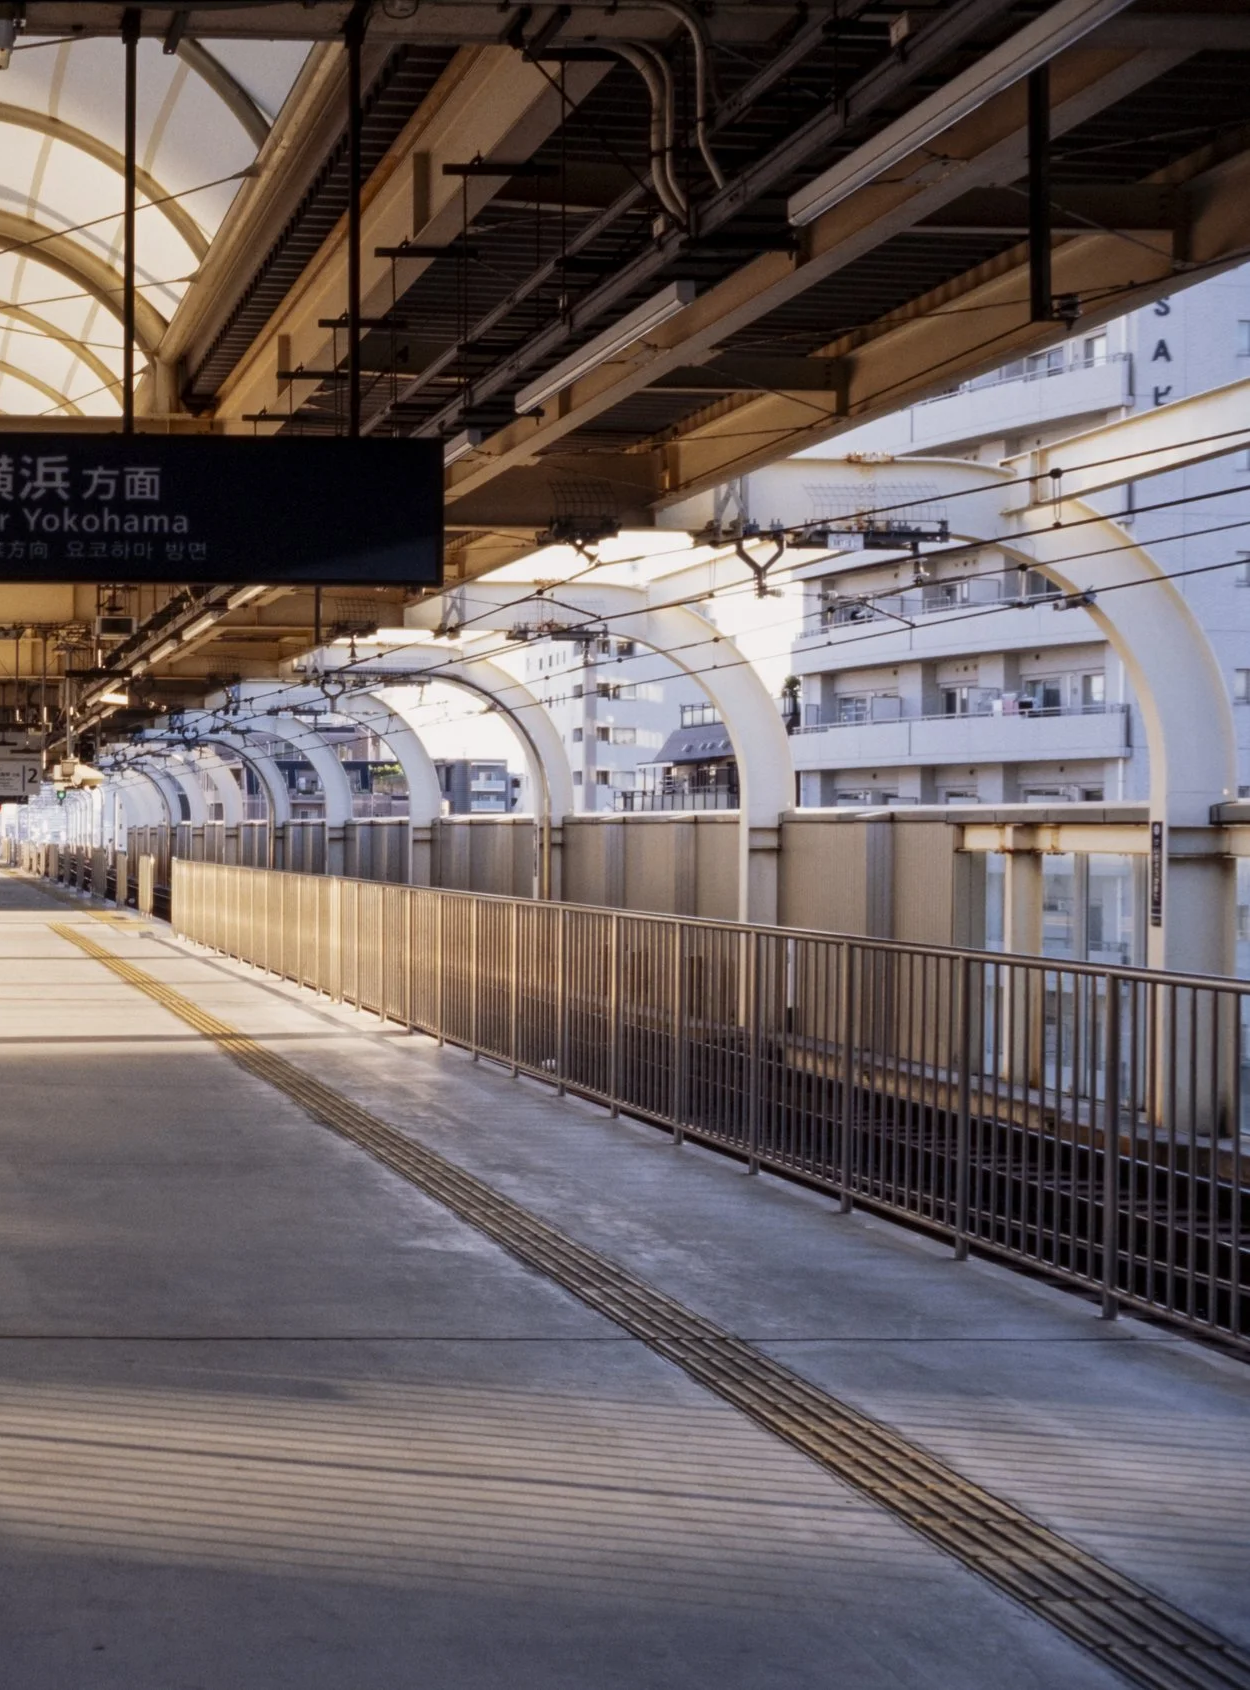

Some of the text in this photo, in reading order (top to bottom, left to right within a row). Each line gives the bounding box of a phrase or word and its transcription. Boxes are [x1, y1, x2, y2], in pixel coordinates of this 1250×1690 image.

[81, 465, 162, 501] 方面
[22, 507, 189, 533] Yokohama
[65, 540, 208, 561] 요코하마 방면
[27, 767, 38, 784] 2
